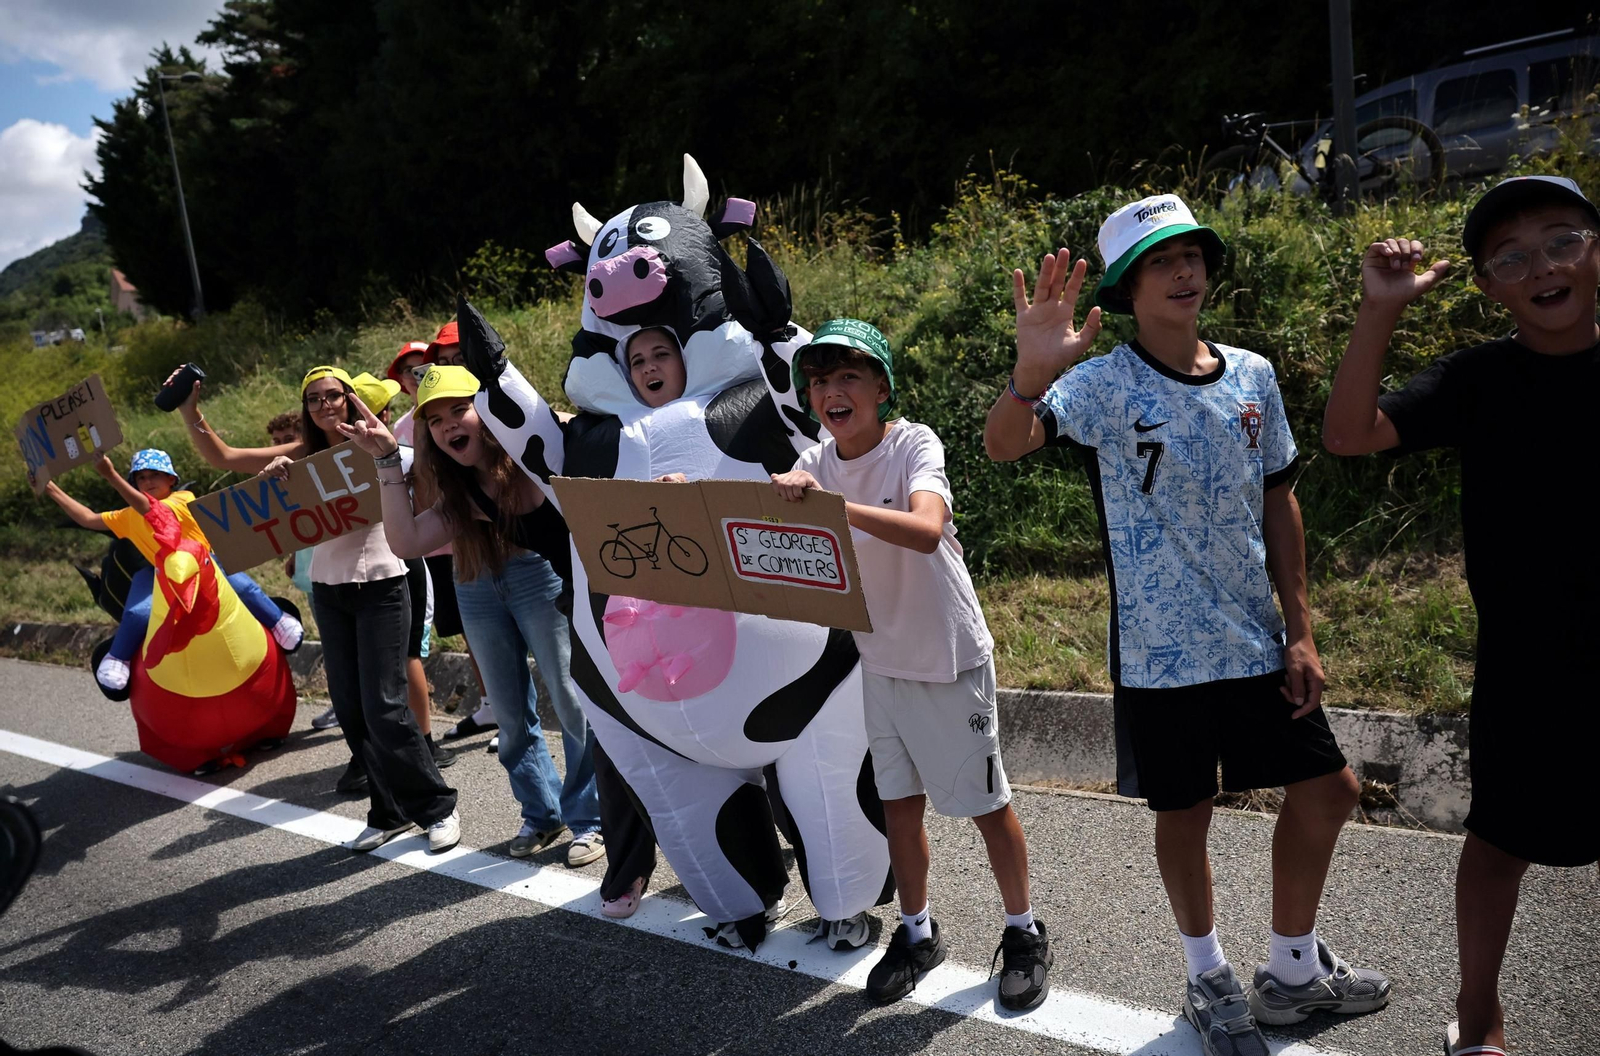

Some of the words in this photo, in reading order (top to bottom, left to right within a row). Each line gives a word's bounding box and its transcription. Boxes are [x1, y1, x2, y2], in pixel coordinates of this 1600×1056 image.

[1133, 202, 1178, 223] Tourtel
[306, 449, 371, 502] LE
[1137, 442, 1164, 495] 7
[252, 497, 369, 555] TOUR
[758, 530, 833, 556] GEORGES
[740, 554, 754, 566] DE
